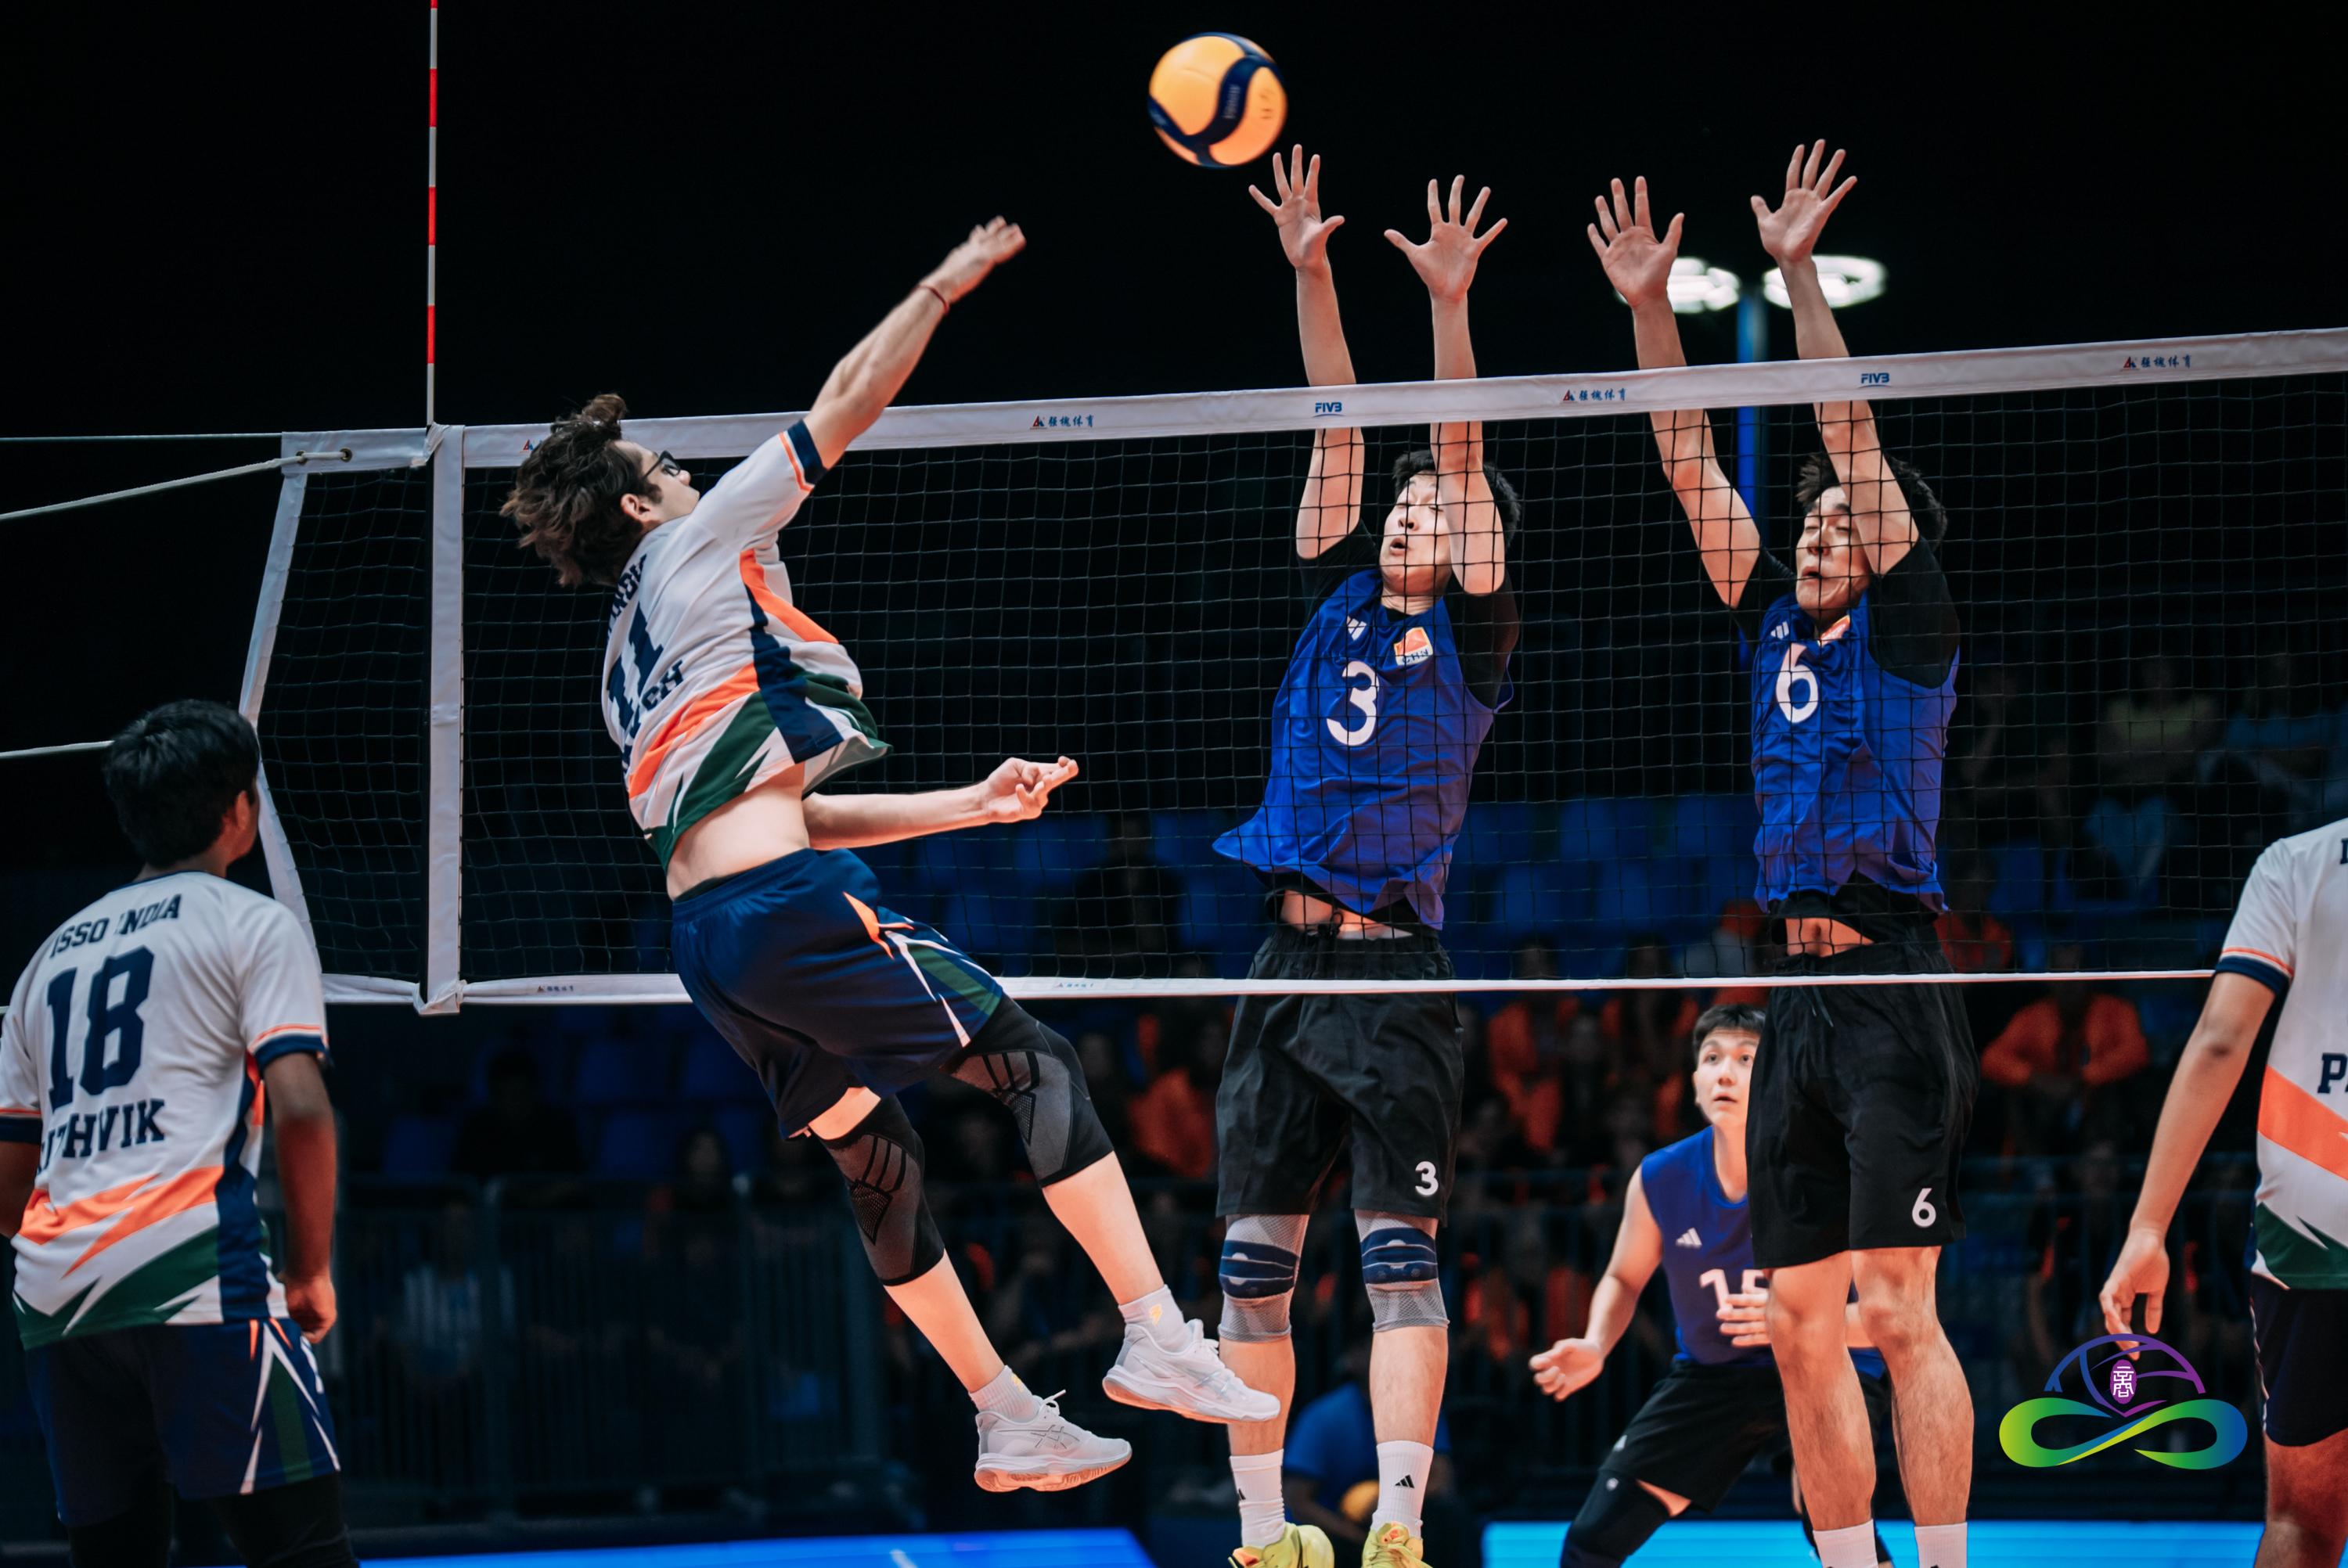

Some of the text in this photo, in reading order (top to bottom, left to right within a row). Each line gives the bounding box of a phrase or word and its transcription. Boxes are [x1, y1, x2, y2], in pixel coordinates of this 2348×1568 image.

[1861, 372, 1889, 384] FIVB
[1315, 401, 1342, 412] FIVB
[1326, 660, 1380, 746] 3
[1776, 642, 1819, 723] 6
[49, 917, 110, 958] ISSO
[47, 944, 155, 1111] 18
[2317, 1052, 2348, 1094] P
[1414, 1161, 1439, 1196] 3
[1911, 1187, 1937, 1228] 6
